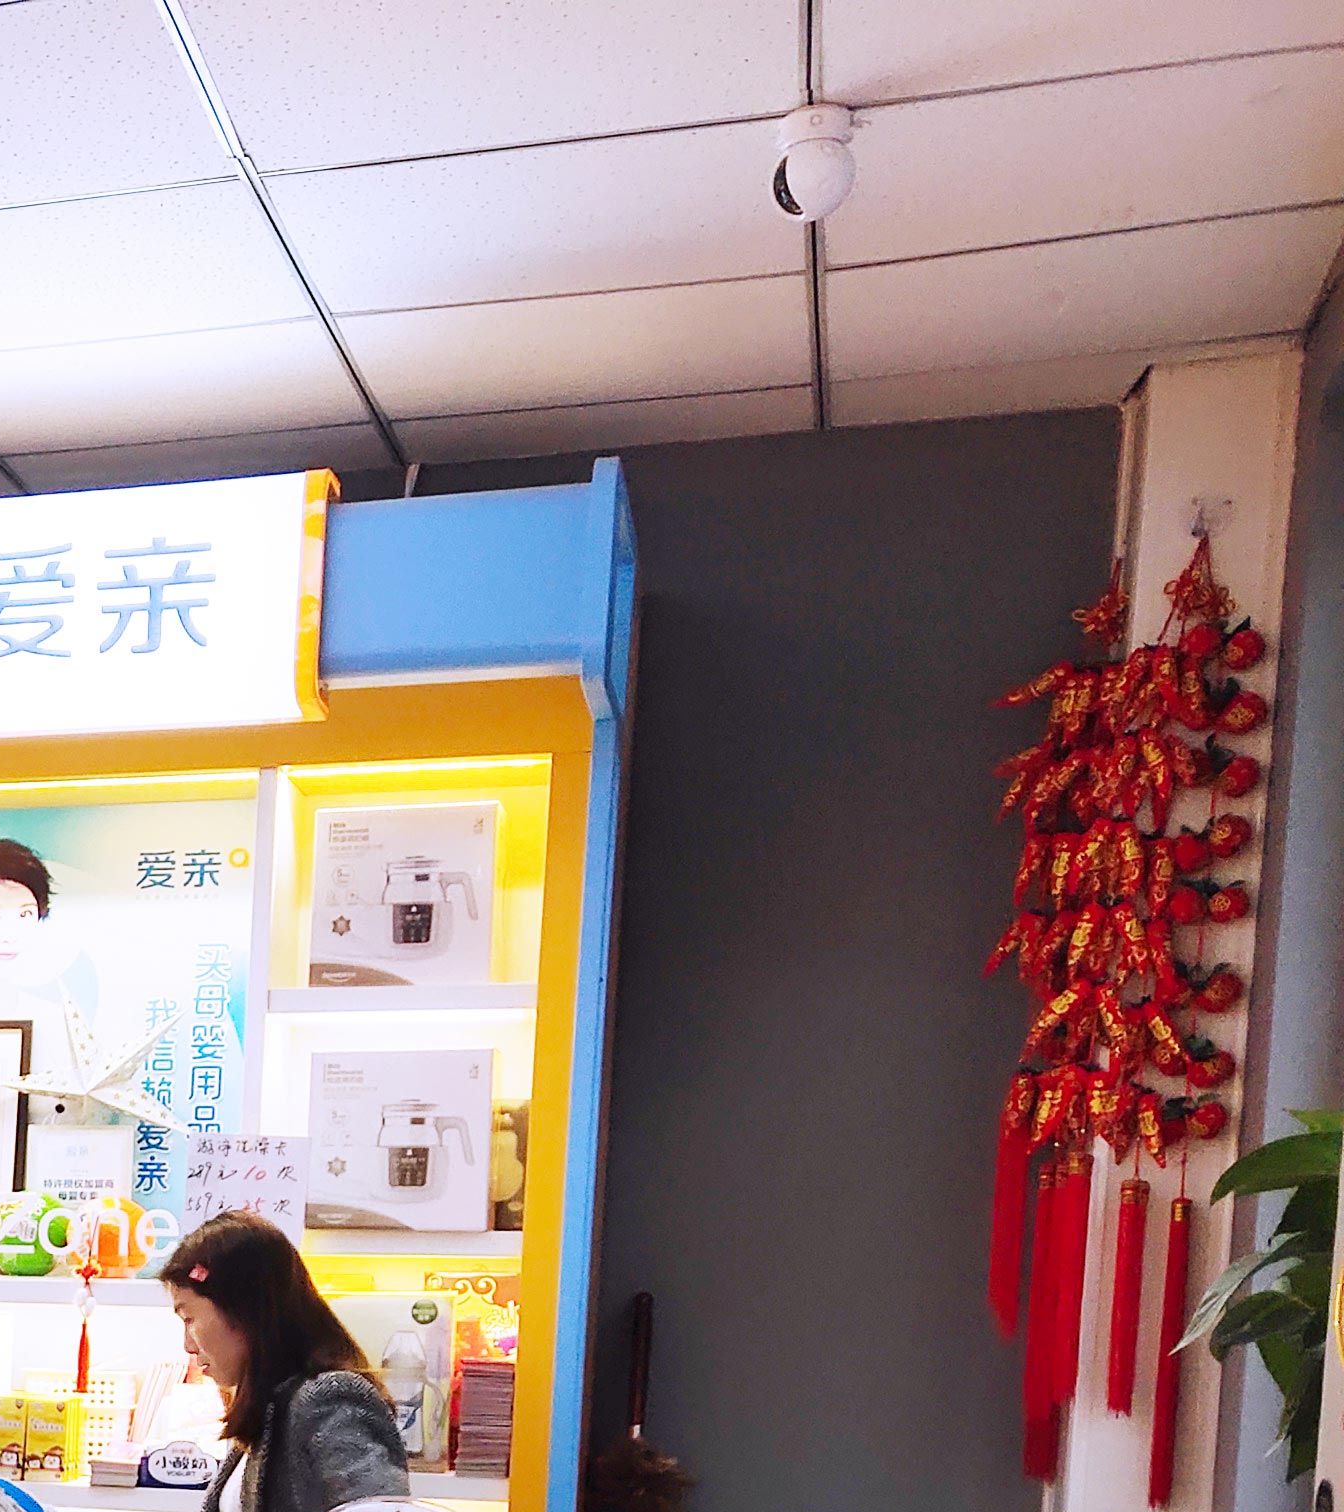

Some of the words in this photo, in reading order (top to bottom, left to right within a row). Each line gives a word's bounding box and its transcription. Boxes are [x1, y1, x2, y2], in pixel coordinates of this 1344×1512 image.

[134, 848, 224, 891] 爱亲
[188, 942, 233, 1134] 买母婴用品
